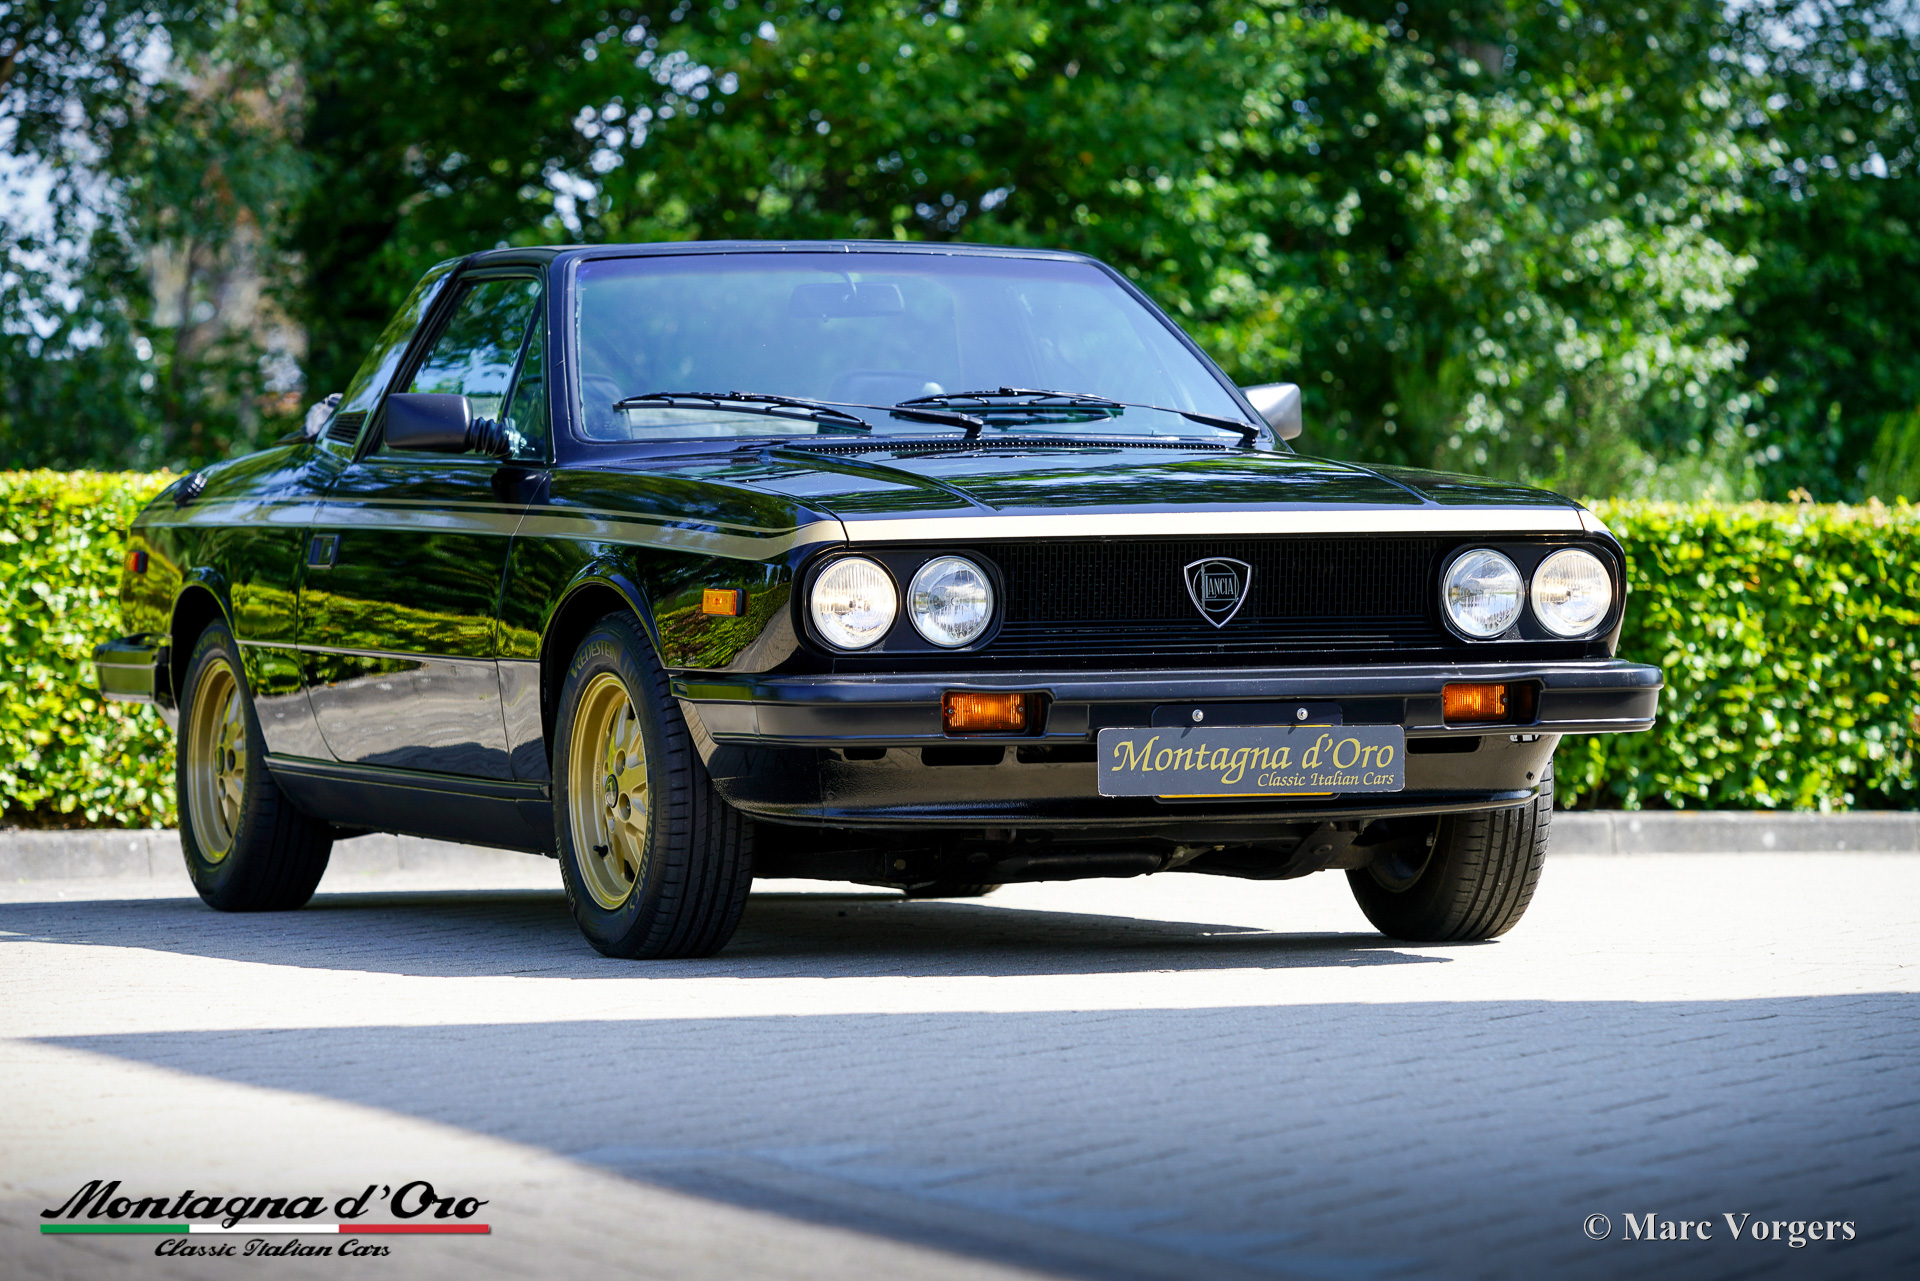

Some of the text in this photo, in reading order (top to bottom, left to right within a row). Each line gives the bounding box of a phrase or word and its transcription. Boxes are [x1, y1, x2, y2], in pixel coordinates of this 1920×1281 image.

[1205, 575, 1234, 598] LANCIA
[570, 639, 617, 679] VREDESTEIN
[1111, 733, 1394, 784] Montagna d'Oro
[1257, 772, 1394, 787] Classic Italian Cars
